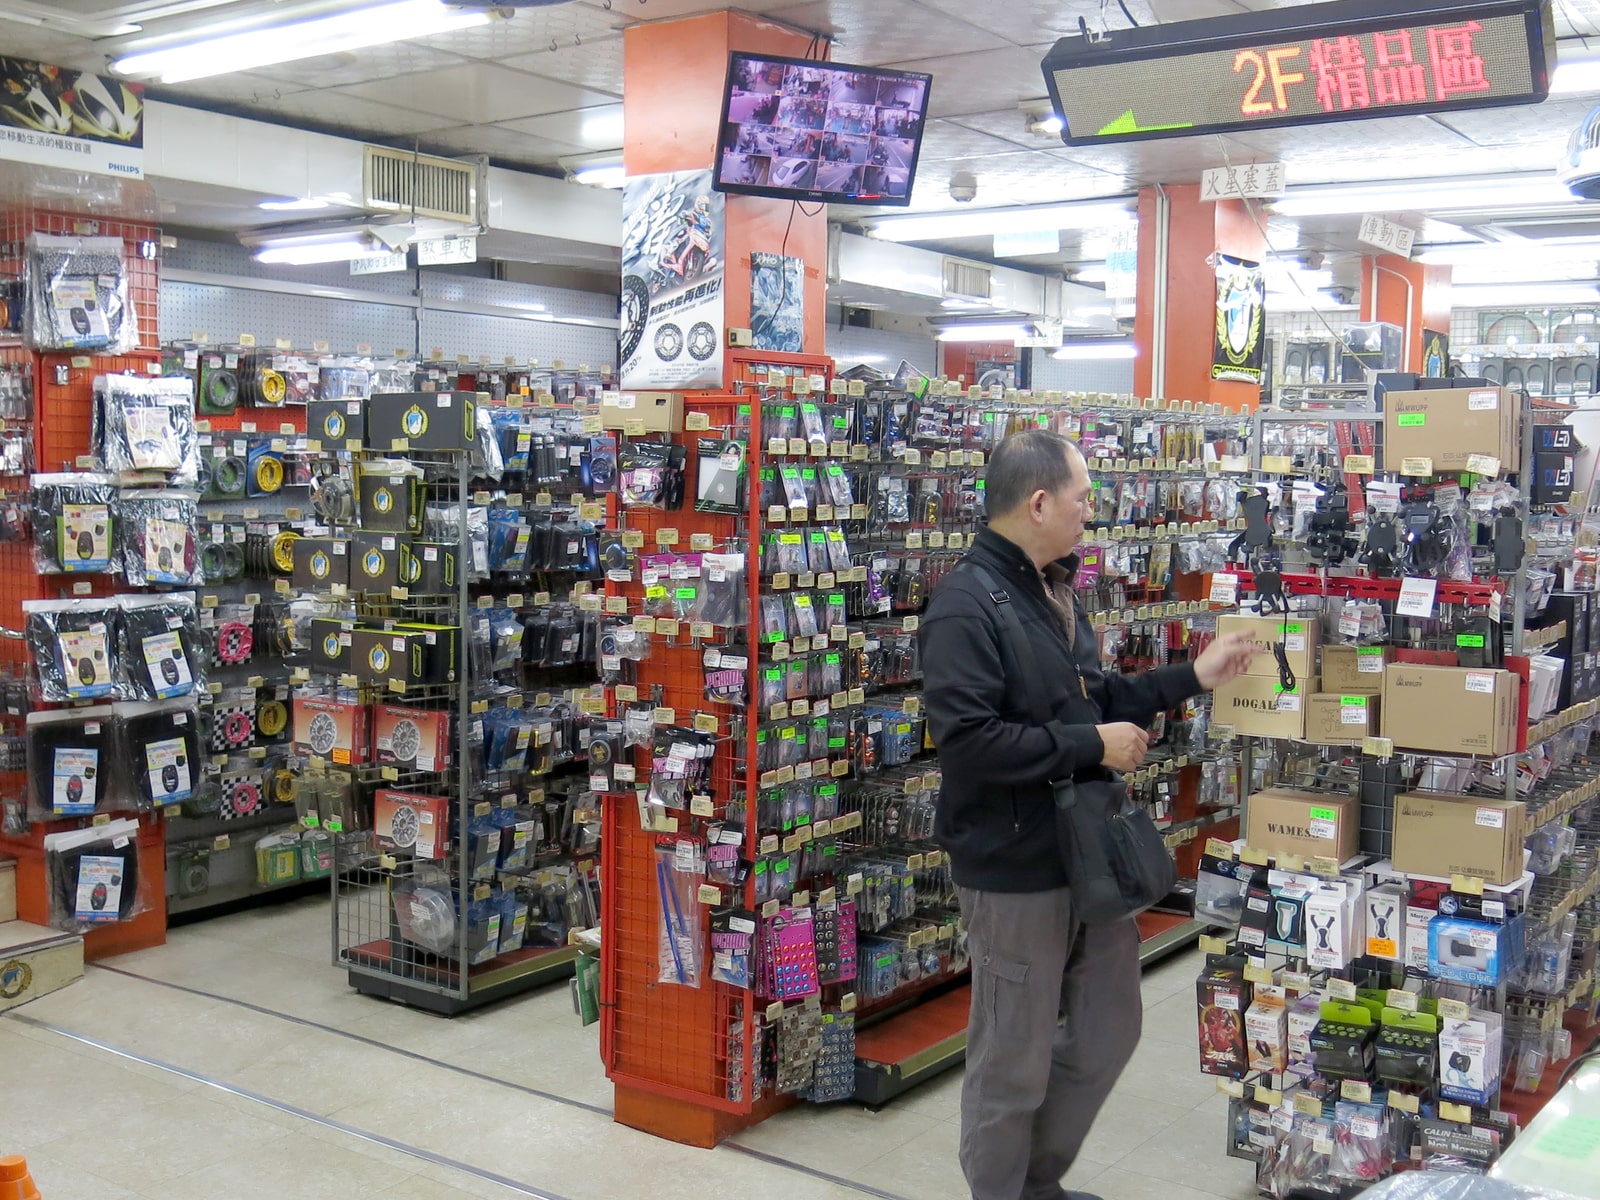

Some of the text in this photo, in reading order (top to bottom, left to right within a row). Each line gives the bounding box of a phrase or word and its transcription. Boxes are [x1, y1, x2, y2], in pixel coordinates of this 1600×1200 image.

[108, 162, 140, 174] PHILIPS
[1205, 164, 1281, 197] 火星塞蓋
[1268, 823, 1319, 838] WAMES
